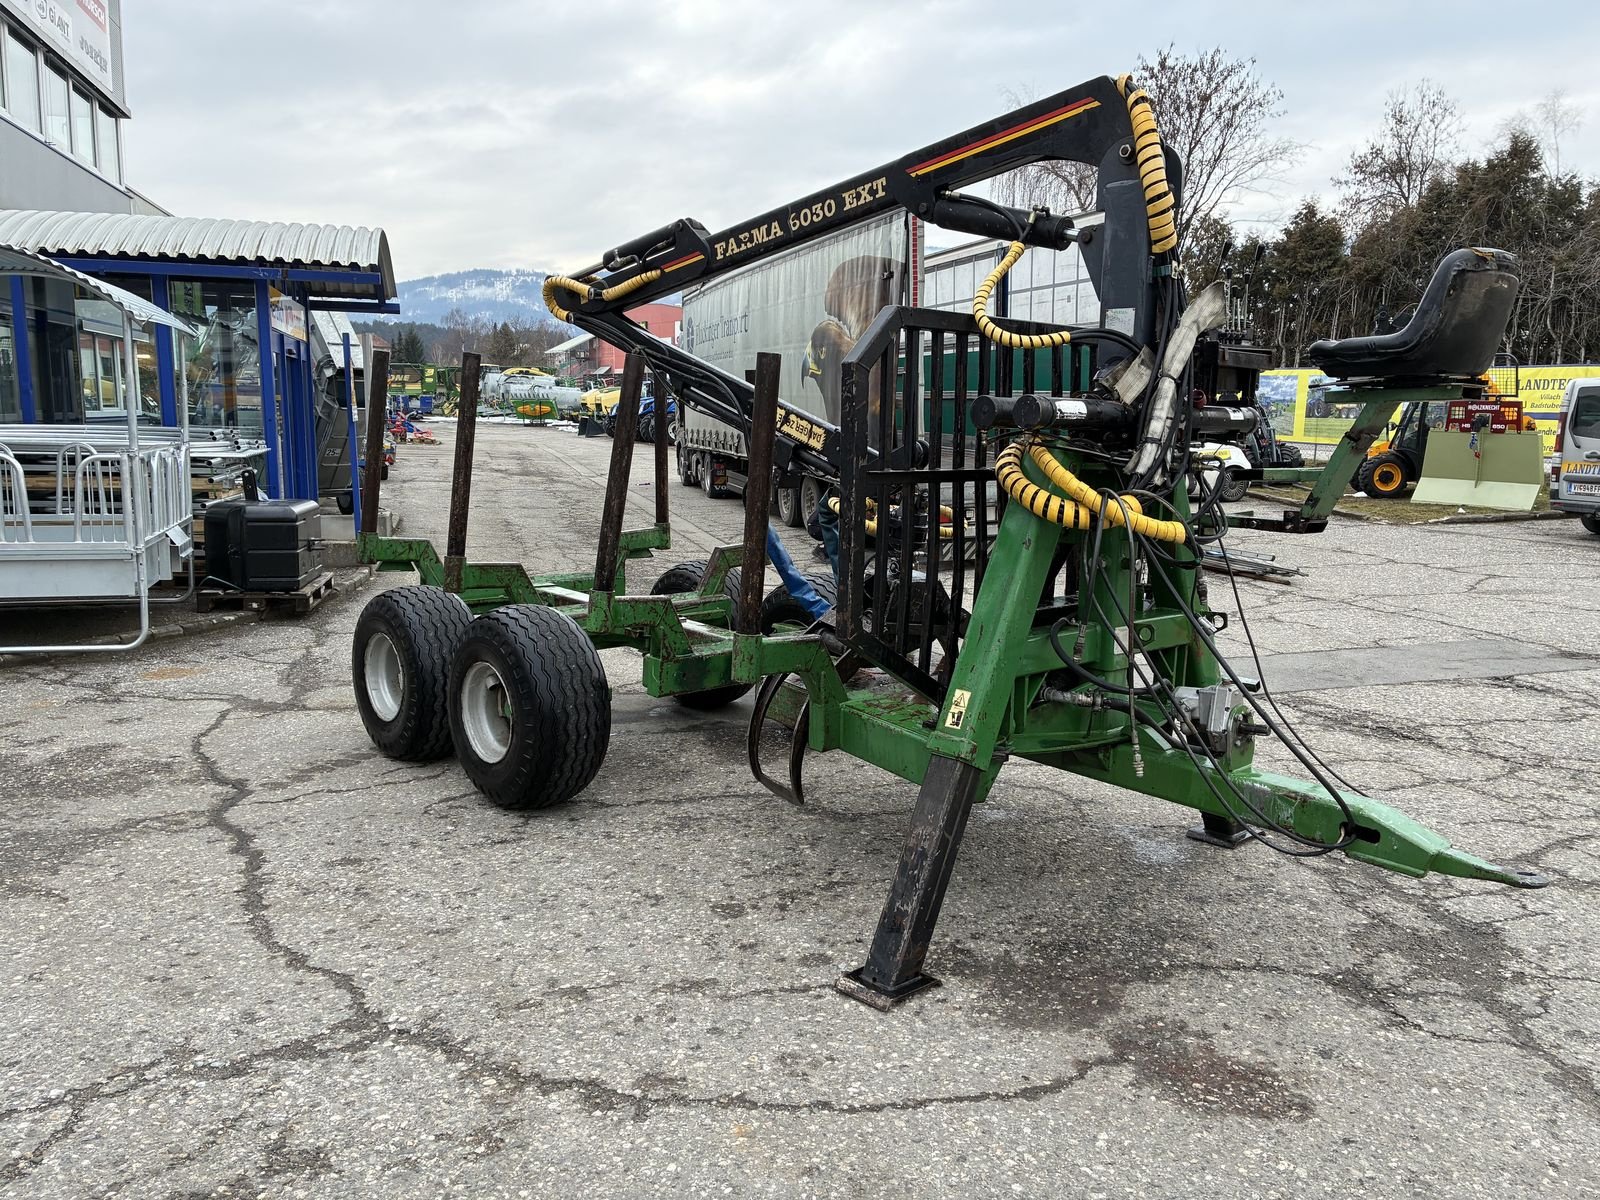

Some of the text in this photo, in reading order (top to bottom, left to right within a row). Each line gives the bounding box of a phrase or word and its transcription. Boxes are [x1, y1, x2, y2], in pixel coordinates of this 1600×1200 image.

[714, 176, 887, 260] FARMA 6030 EXT
[1566, 463, 1600, 474] LANDT
